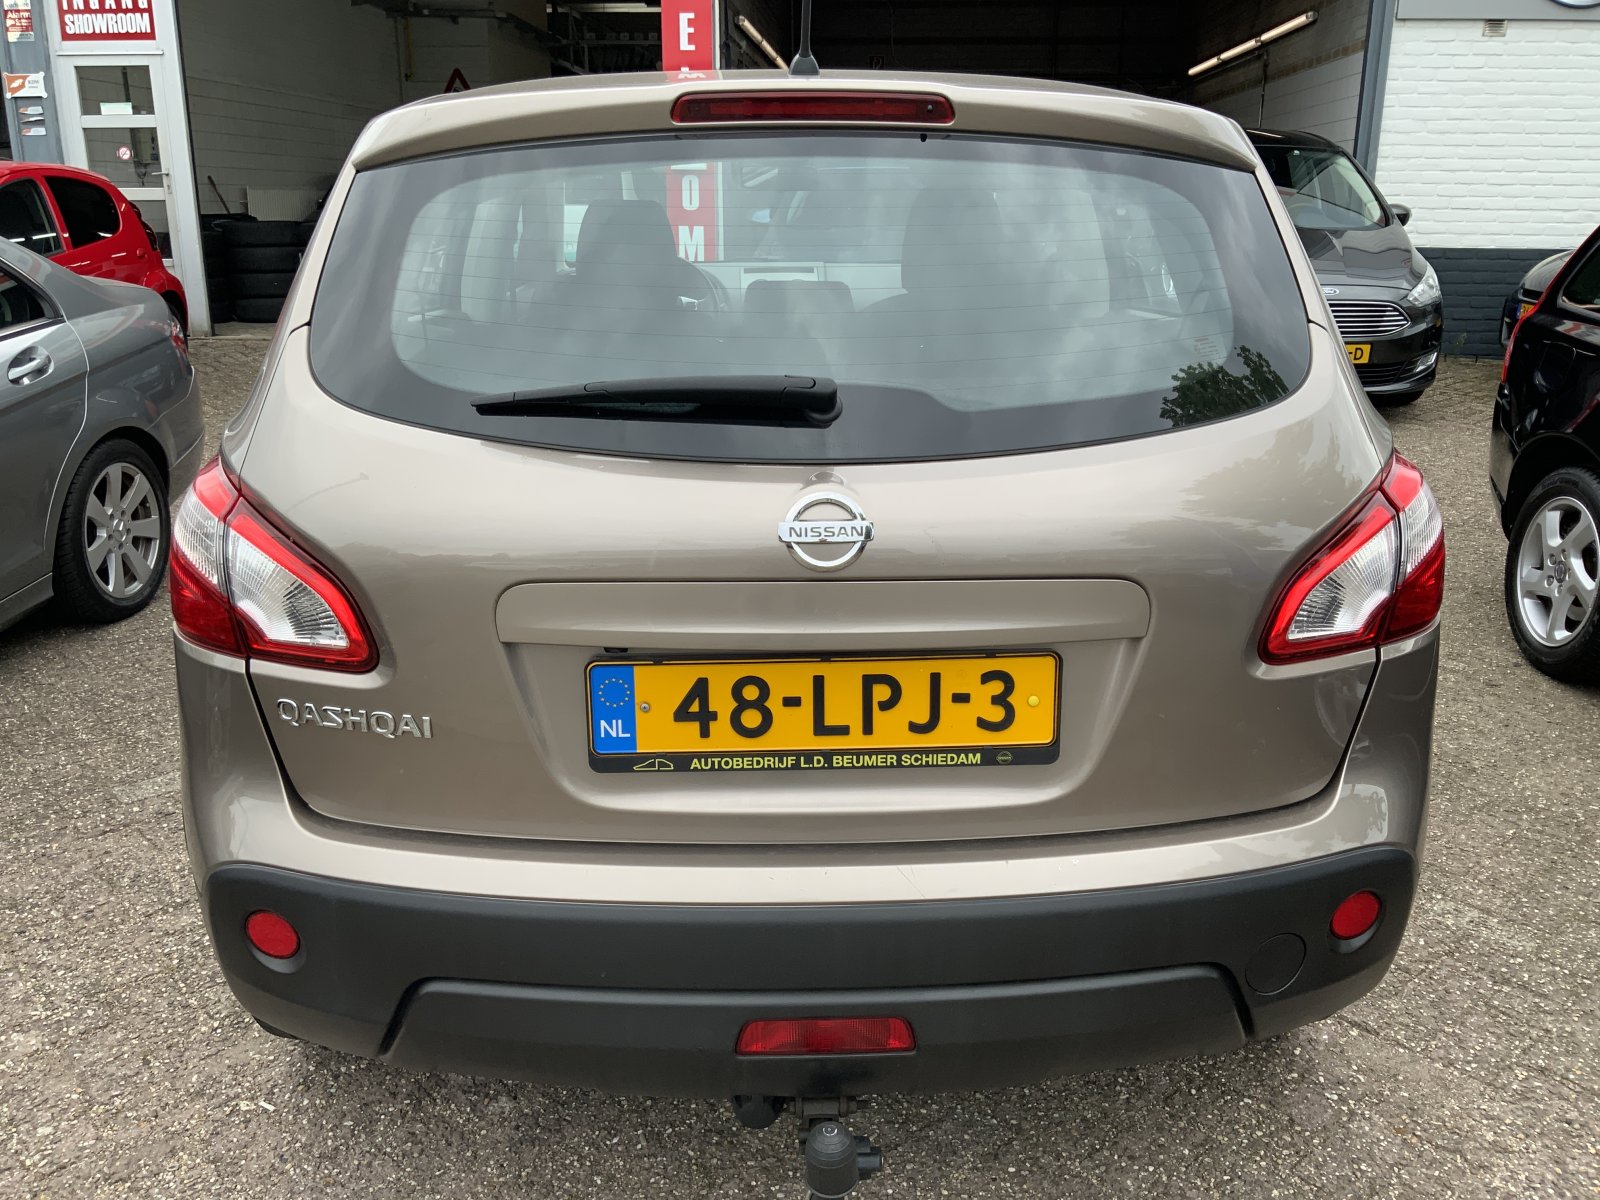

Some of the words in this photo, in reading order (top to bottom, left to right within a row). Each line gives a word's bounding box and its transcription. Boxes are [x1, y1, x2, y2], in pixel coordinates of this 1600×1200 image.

[64, 12, 151, 34] SHOWROOM
[788, 526, 864, 538] NISSAN
[673, 670, 1016, 739] 48-LPJ-3
[277, 698, 433, 739] QASHQAI
[600, 719, 631, 738] NL
[690, 756, 797, 770] AUTOBEDRIJF
[800, 756, 829, 768] L.D.
[832, 755, 897, 768] BEUMER
[901, 753, 981, 766] SCHIEDAM
